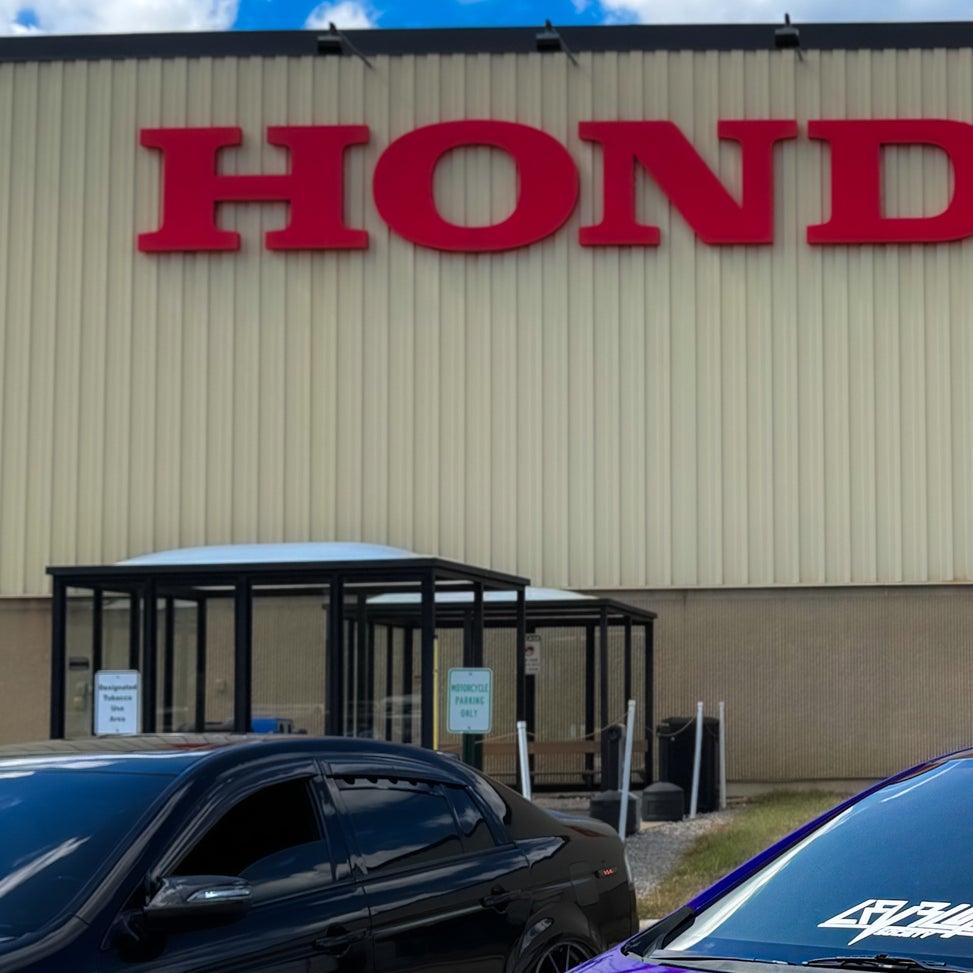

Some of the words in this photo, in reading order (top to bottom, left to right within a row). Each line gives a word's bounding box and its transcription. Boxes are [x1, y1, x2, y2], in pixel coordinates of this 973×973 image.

[452, 683, 489, 693] MOTORCYCLE
[455, 696, 485, 705] PARKING
[460, 709, 478, 718] ONLY
